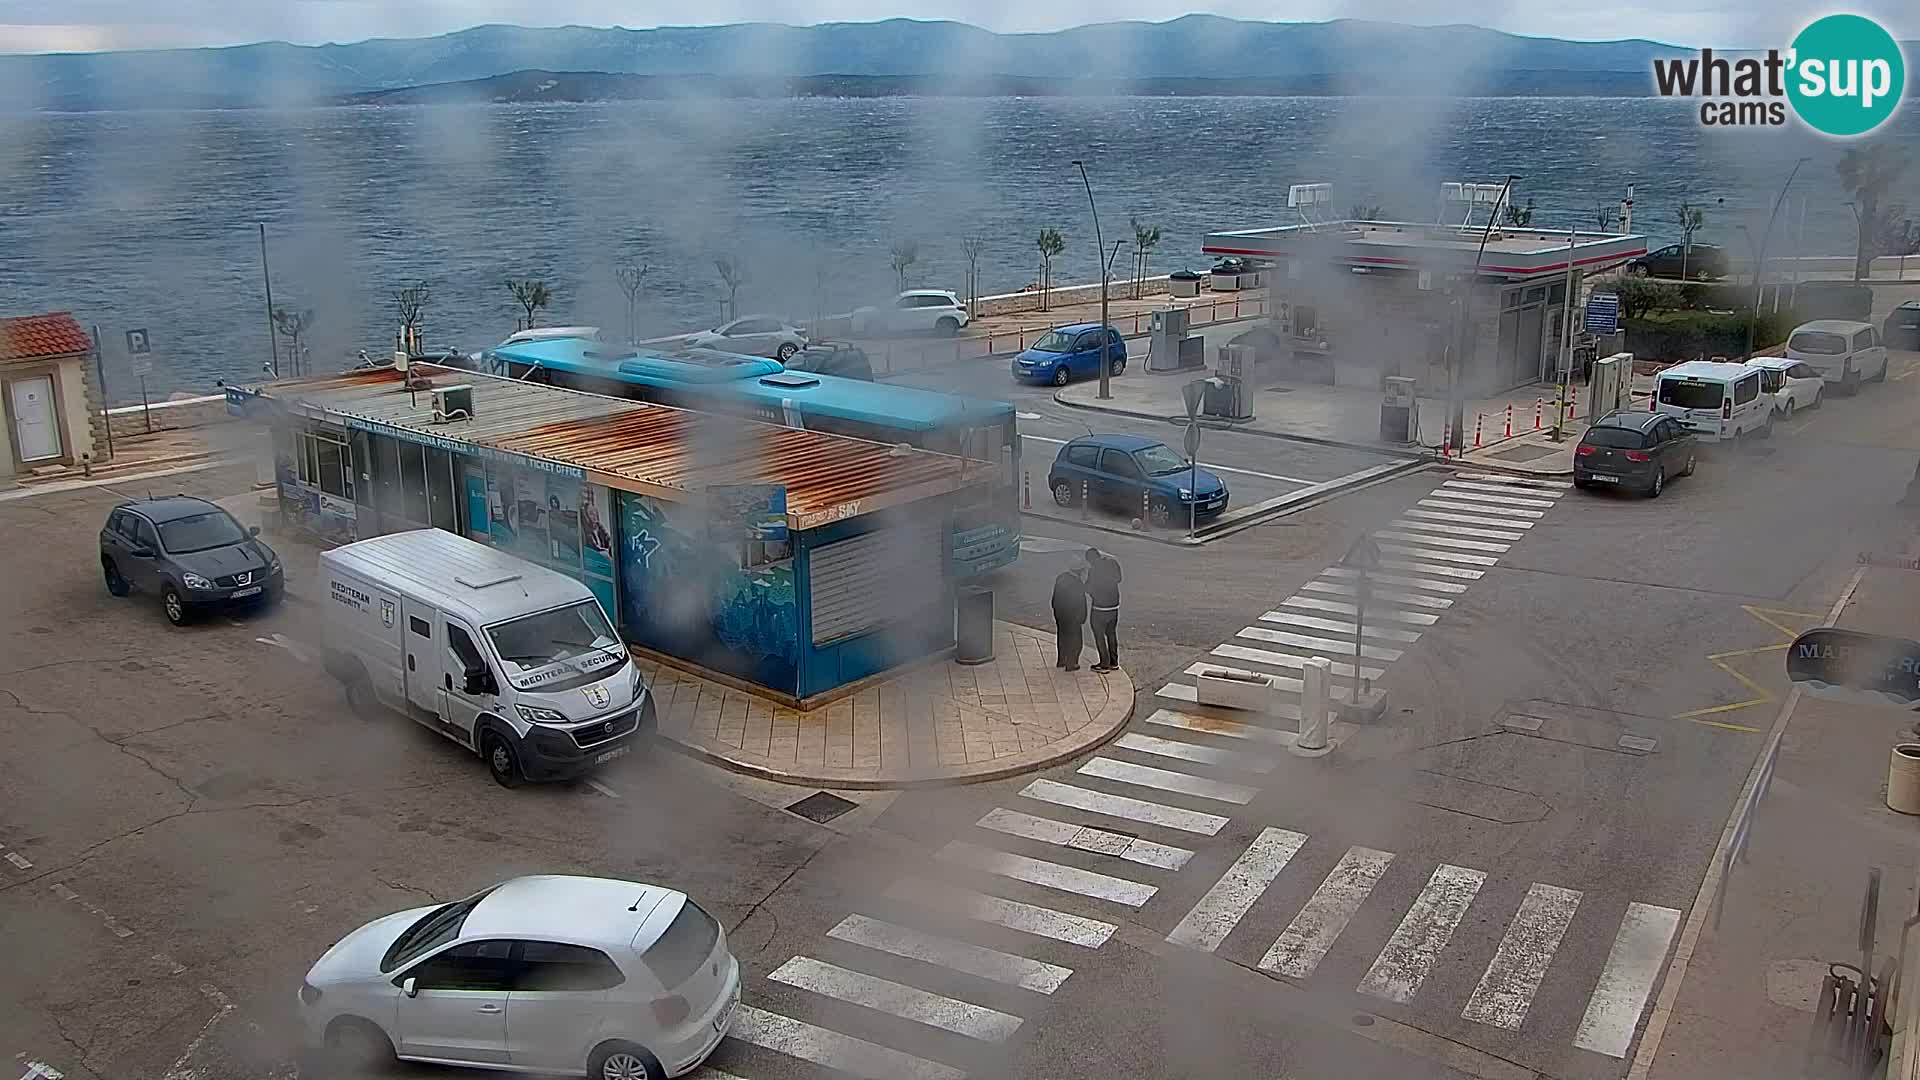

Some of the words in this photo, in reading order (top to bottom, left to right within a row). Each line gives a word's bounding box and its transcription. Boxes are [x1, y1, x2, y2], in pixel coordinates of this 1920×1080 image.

[131, 332, 144, 353] P
[396, 428, 437, 446] AUTOBUSNA
[437, 437, 468, 453] POSTAJA
[495, 450, 527, 466] STATION
[527, 458, 556, 473] TICKET
[556, 463, 583, 478] OFFICE
[331, 580, 370, 604] MEDITERAN
[331, 591, 361, 610] SECURITY
[520, 663, 579, 687] MEDITERAN
